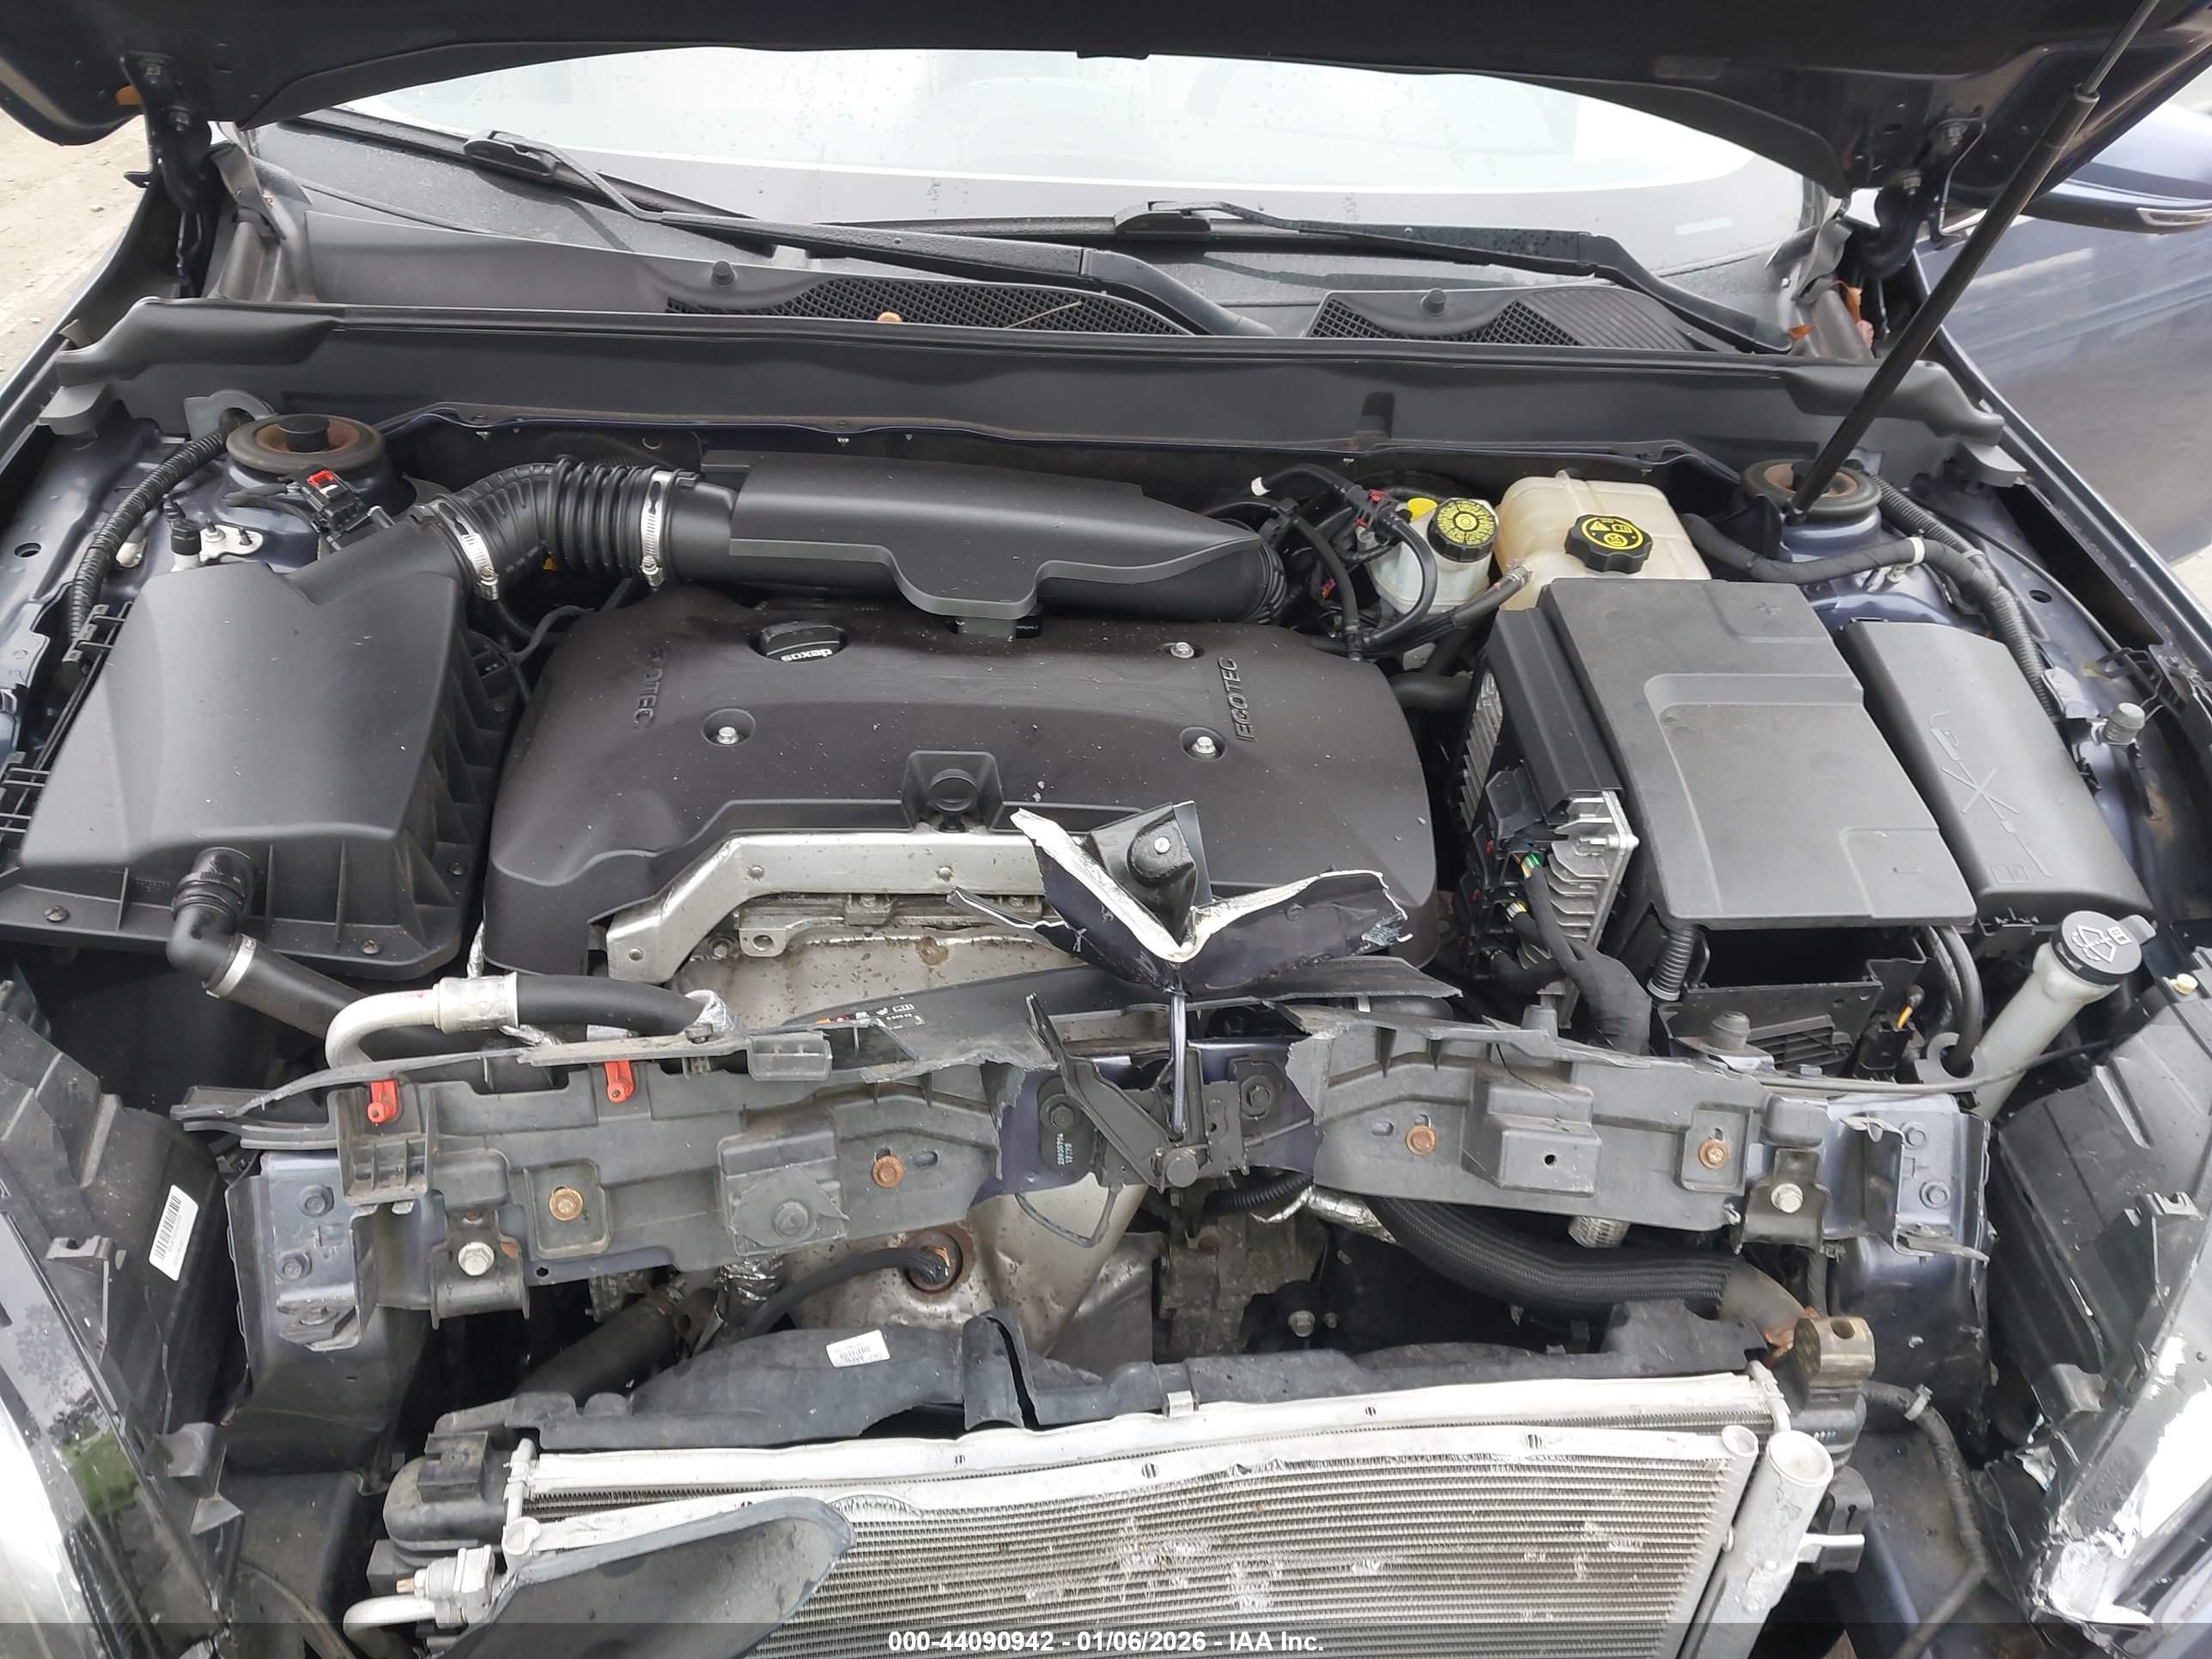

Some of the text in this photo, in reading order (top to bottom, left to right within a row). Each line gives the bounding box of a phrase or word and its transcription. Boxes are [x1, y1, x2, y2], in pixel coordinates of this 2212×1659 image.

[634, 647, 665, 728] OTEC
[781, 648, 833, 662] dexos
[1218, 657, 1256, 742] ECOTEC
